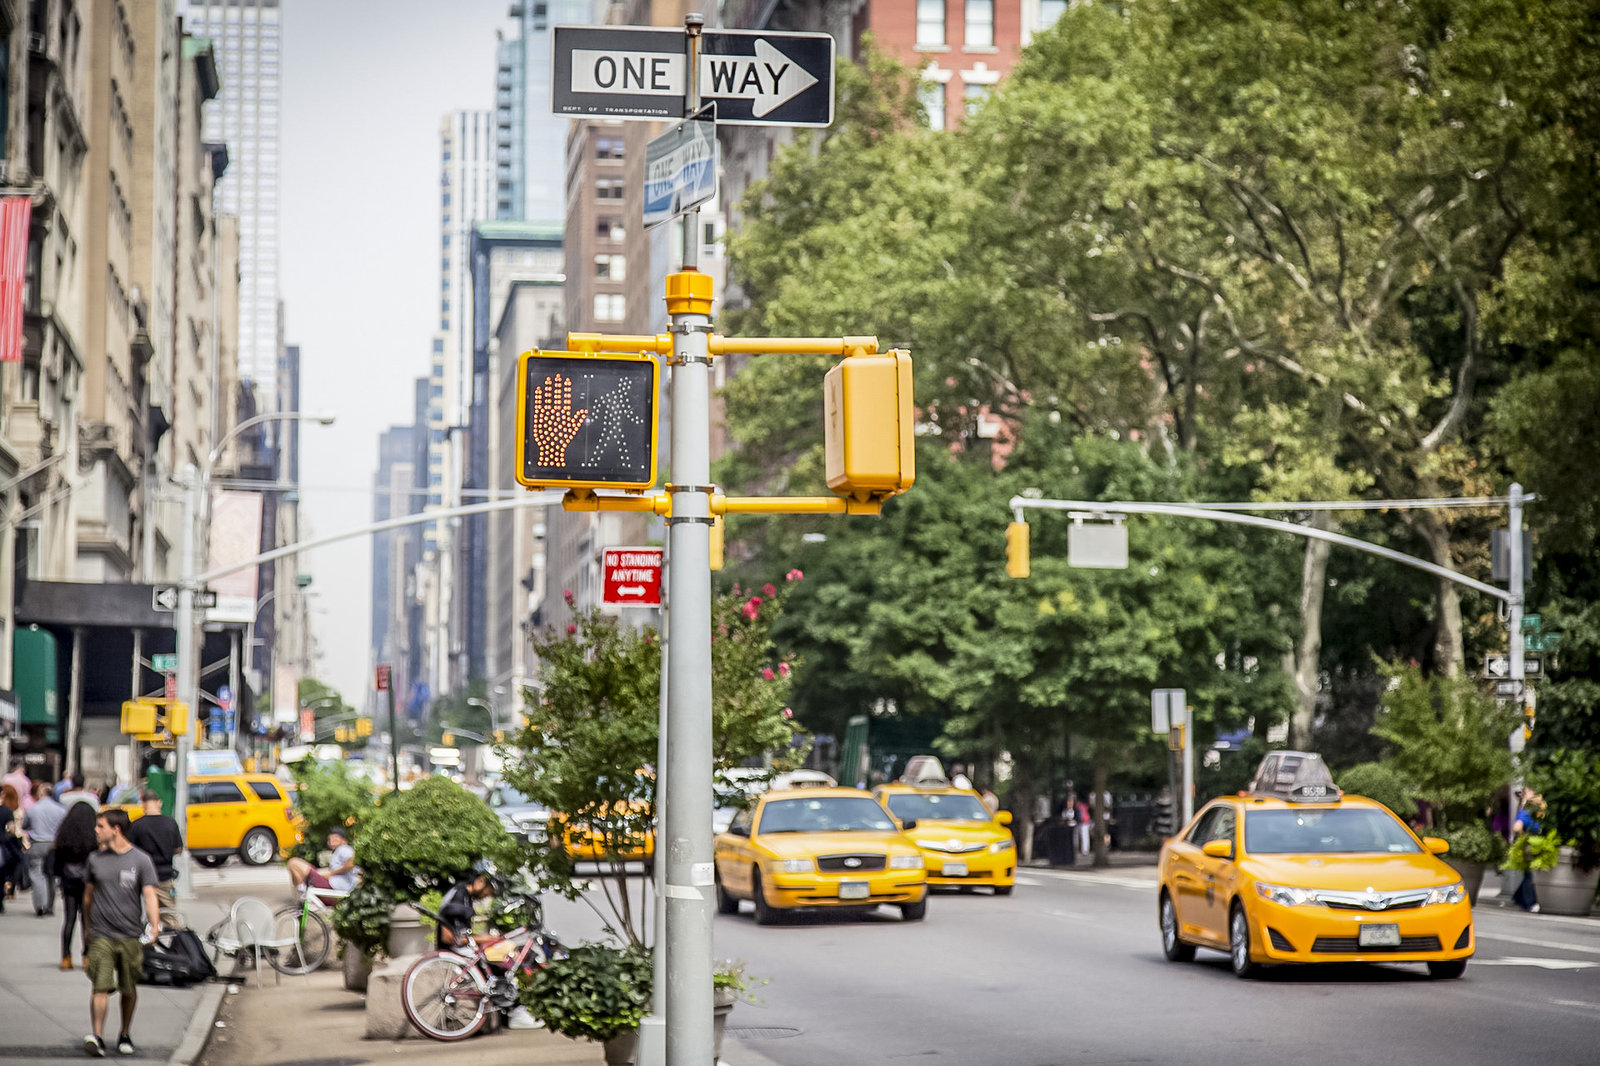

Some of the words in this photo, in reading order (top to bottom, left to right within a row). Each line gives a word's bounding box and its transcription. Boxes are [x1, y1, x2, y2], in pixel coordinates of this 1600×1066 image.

[594, 55, 671, 91] ONE
[710, 60, 790, 96] WAY
[605, 107, 669, 115] TRANSPORTATION
[653, 158, 674, 198] ONE
[682, 139, 704, 183] WAY
[606, 553, 619, 567] NO
[620, 553, 661, 567] STANDING
[611, 569, 654, 583] ANYTIME
